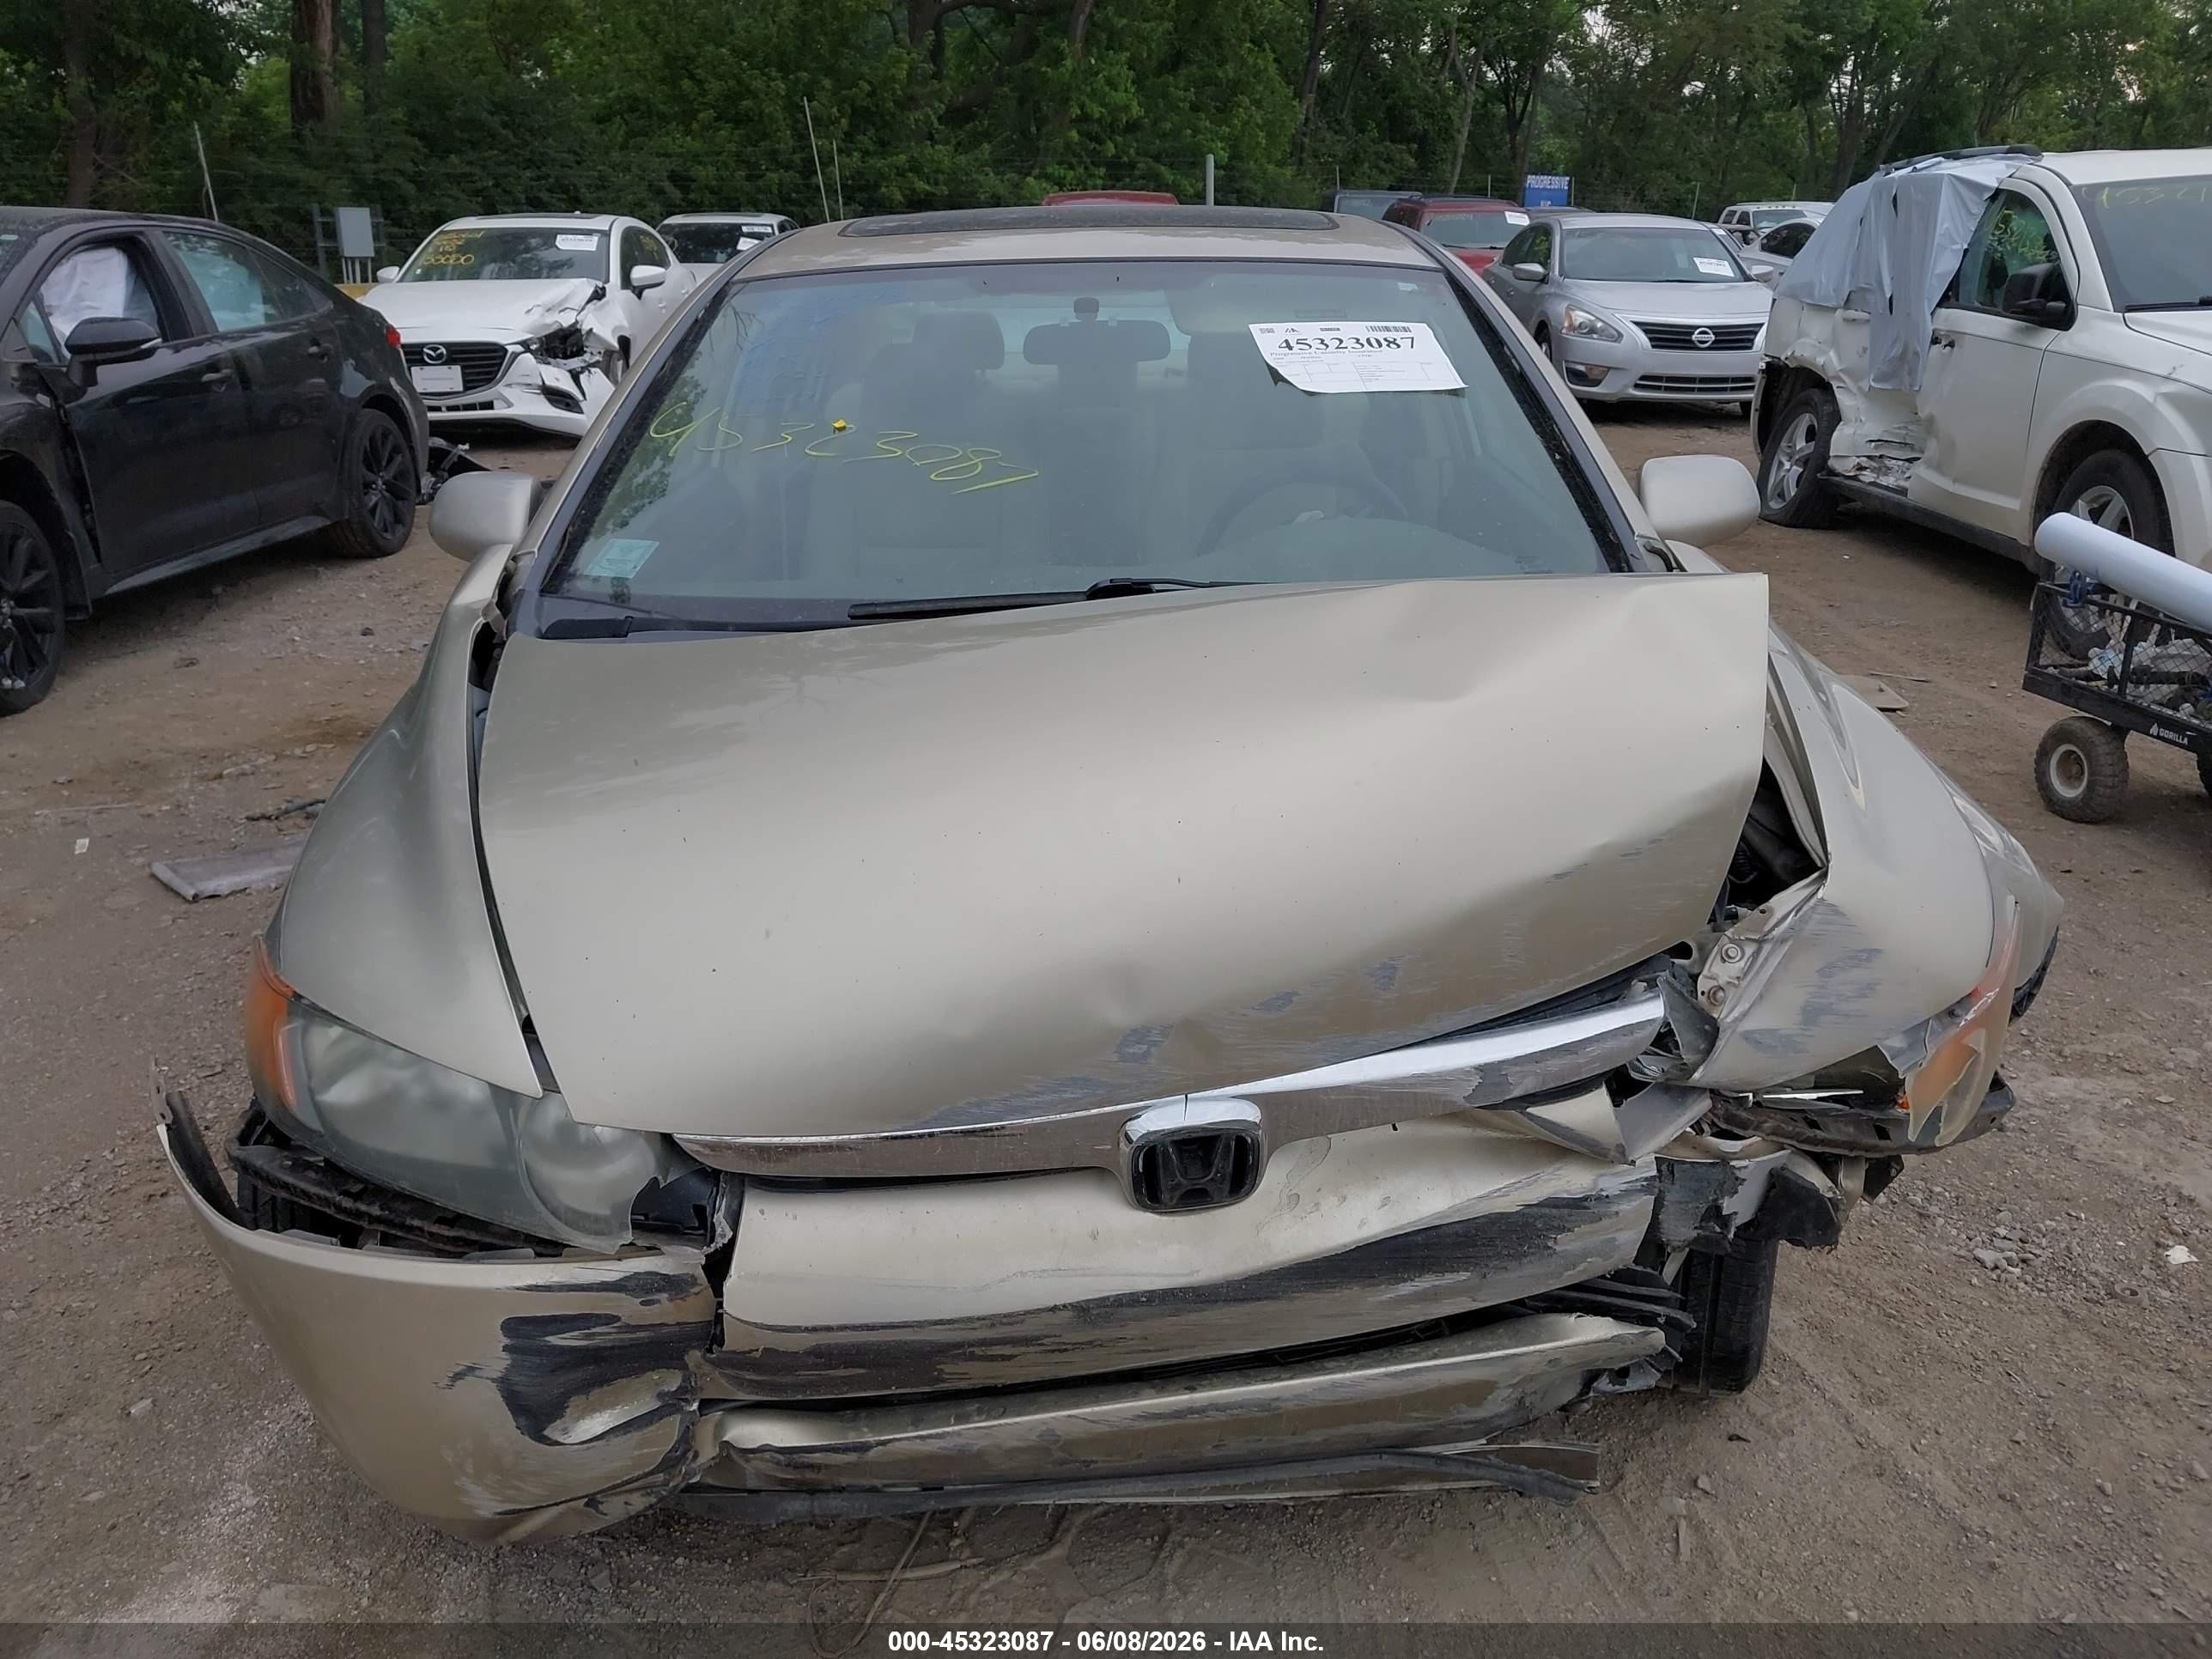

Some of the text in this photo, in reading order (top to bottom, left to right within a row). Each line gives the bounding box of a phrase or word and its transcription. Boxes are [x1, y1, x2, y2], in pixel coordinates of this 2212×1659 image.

[1527, 175, 1570, 189] PROGRESSIVE
[1278, 336, 1415, 351] 45323087
[2159, 728, 2189, 745] GORILLA
